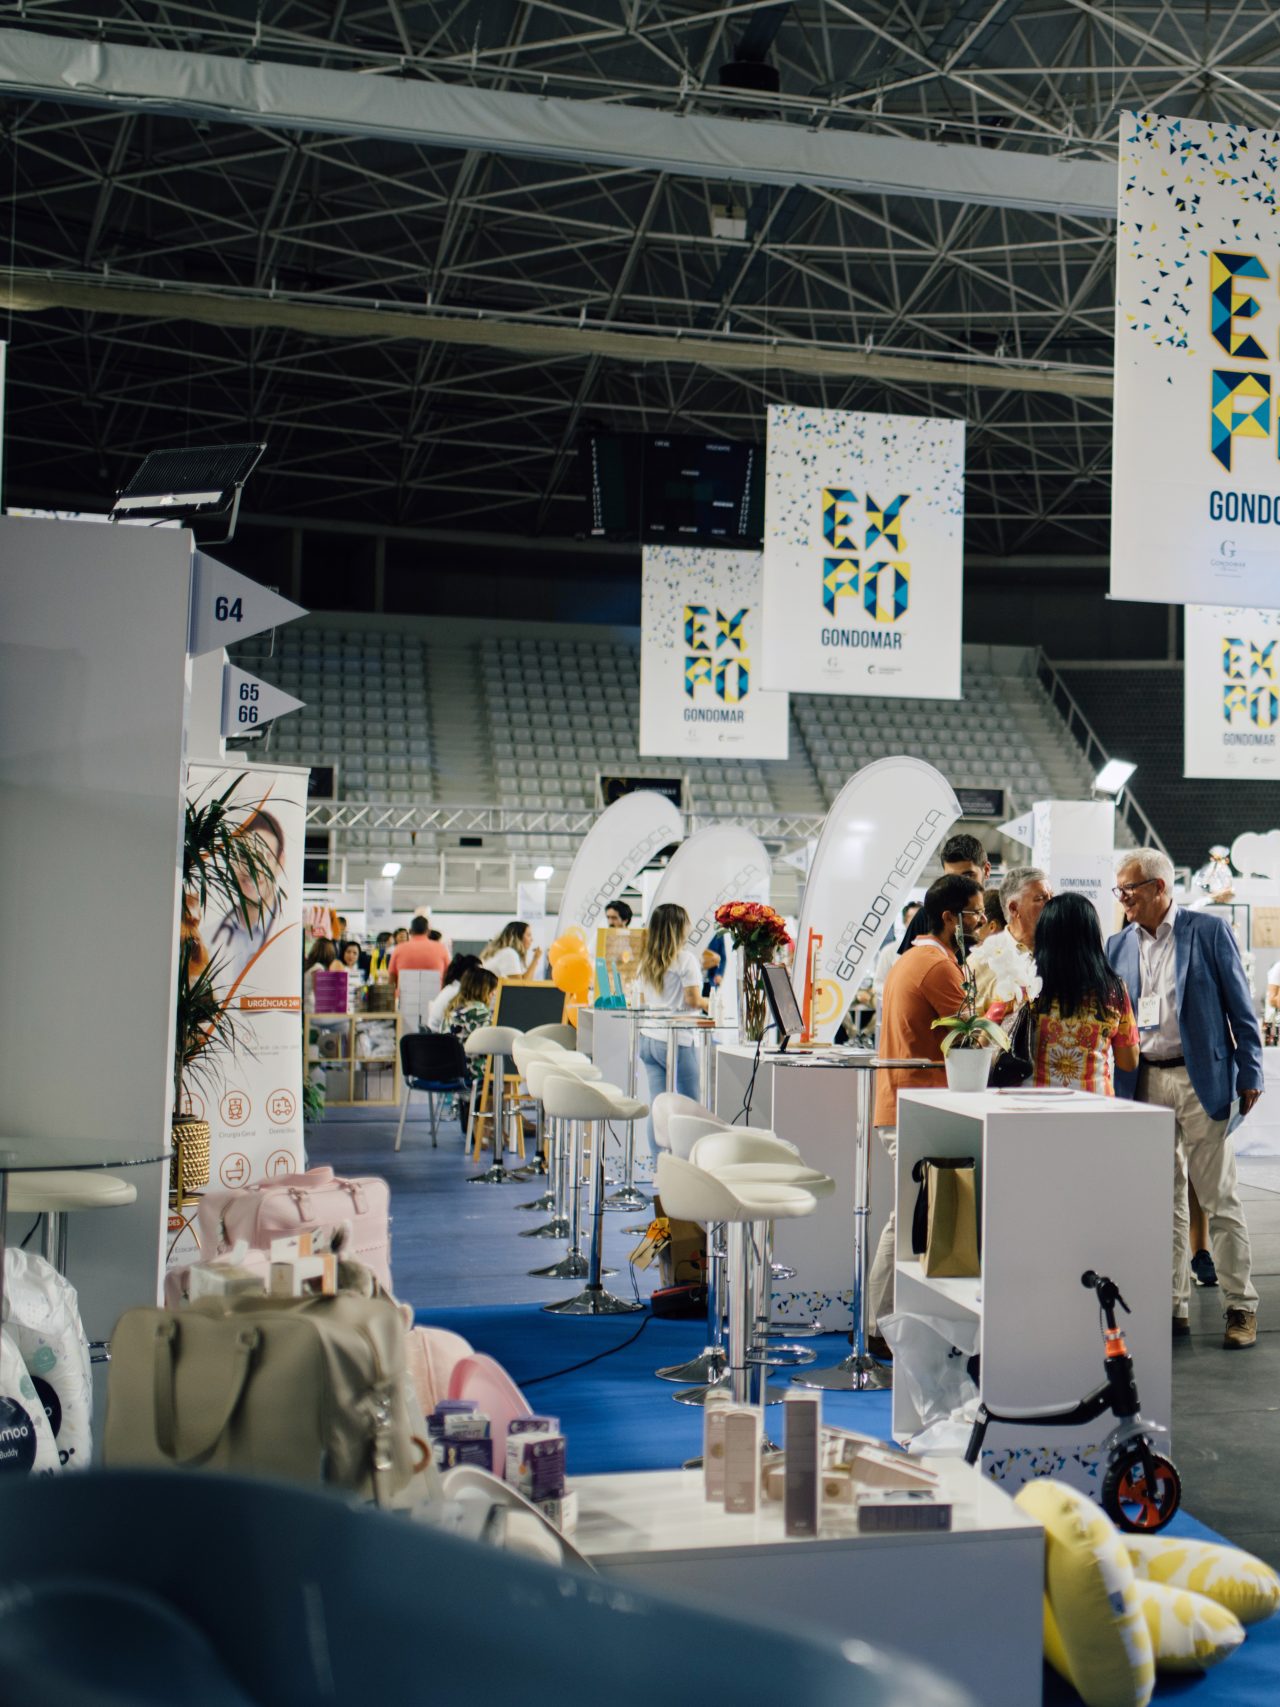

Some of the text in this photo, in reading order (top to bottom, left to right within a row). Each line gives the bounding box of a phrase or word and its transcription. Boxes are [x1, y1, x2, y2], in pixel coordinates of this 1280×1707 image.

[821, 486, 911, 553] EX
[821, 557, 911, 623] PO
[215, 597, 243, 622] 64
[683, 604, 750, 652] EX
[821, 628, 902, 650] GONDOMAR
[1222, 637, 1279, 680] EX
[683, 656, 751, 702] PO
[240, 683, 259, 701] 65
[238, 705, 258, 723] 66
[683, 708, 744, 724] GONDOMAR
[1223, 684, 1280, 728] PO
[1223, 733, 1276, 746] GONDOMAR
[1018, 826, 1028, 835] 57
[247, 998, 288, 1008] URGÊNCIAS
